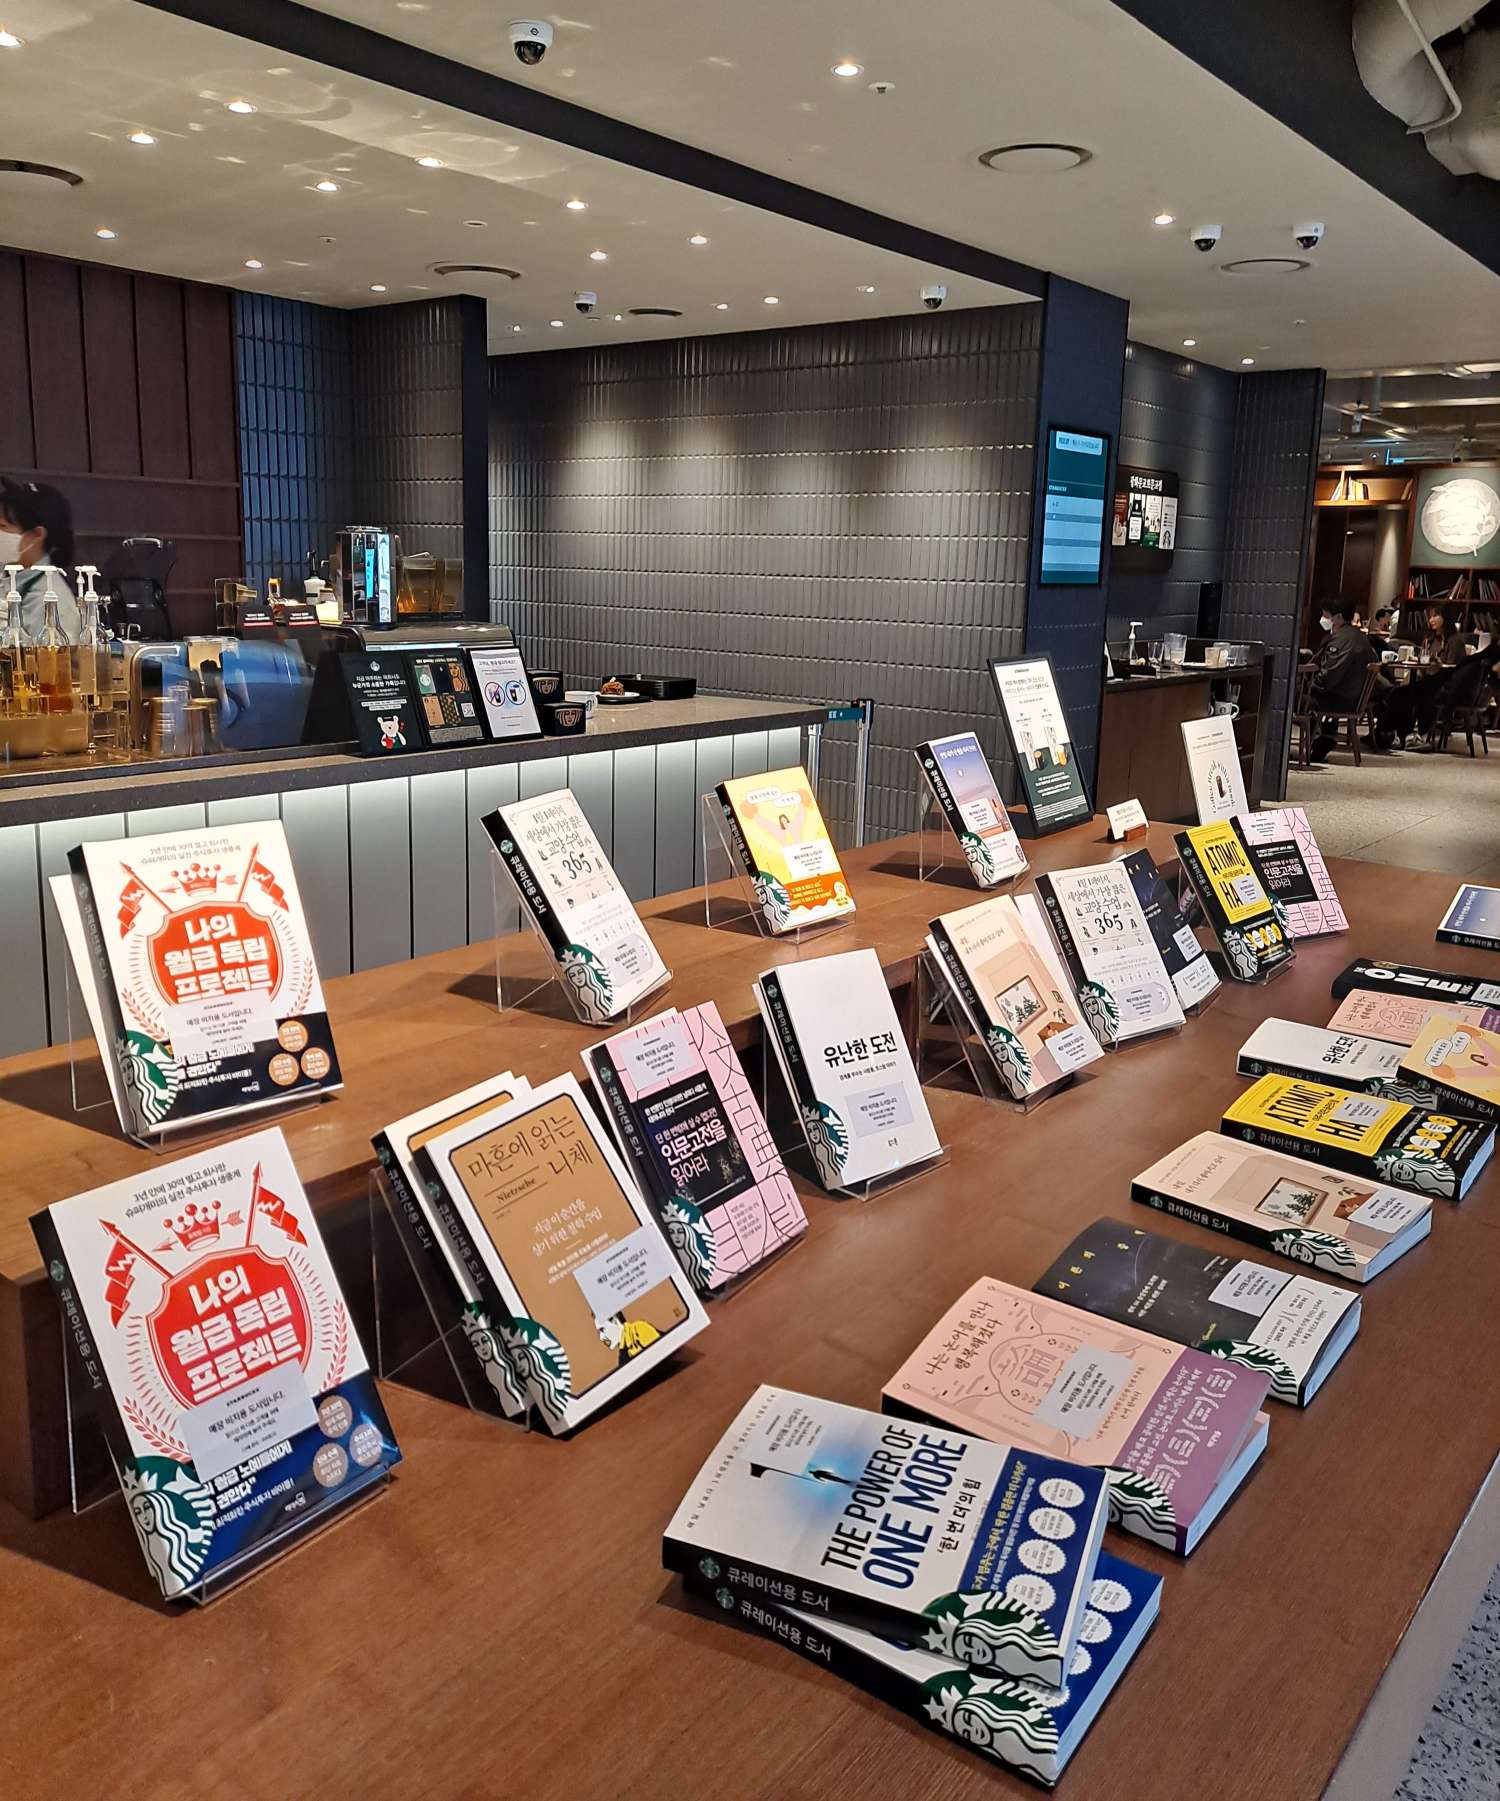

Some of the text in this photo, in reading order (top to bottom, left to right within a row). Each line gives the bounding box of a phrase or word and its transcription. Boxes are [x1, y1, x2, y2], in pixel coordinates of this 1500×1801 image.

[562, 851, 592, 880] 365
[1204, 841, 1246, 875] ATOMIC
[1264, 864, 1303, 879] 인문고전을
[510, 855, 546, 914] 큐레이션용 도서
[1269, 877, 1291, 890] 읽어라
[1083, 897, 1122, 914] 교양 수업
[1095, 912, 1124, 935] 365
[185, 914, 237, 943] 나의
[1065, 942, 1074, 956] 도서
[165, 937, 268, 976] 월급 독립
[176, 968, 273, 1004] 프로젝트
[945, 953, 976, 1006] 큐레이션용 도서
[1363, 967, 1462, 992] ONE
[774, 1002, 799, 1063] 큐레이션용 도서
[824, 1031, 898, 1069] 유난한 도전
[1323, 1036, 1358, 1064] 유난한 도전
[609, 1086, 644, 1156] 큐레이션용 도서
[1263, 1085, 1336, 1128] ATOMIC
[1435, 1086, 1495, 1116] 큐레이션용 도서
[467, 1114, 576, 1179] 마흔에 읽는
[547, 1138, 593, 1176] 니체
[661, 1119, 727, 1166] 인문고전을
[1260, 1133, 1320, 1157] 큐레이션용 도서
[496, 1177, 537, 1203] Nietzsche
[670, 1154, 711, 1187] 읽어라
[124, 1169, 241, 1218] 슈퍼개미의 실전 주식투자 생중계
[388, 1169, 432, 1250] 큐레이션용 도서
[548, 1227, 569, 1245] 위한
[1167, 1204, 1229, 1232] 큐레이션용 도서
[438, 1203, 485, 1285] 큐레이션용 도서
[188, 1265, 253, 1315] 나의
[61, 1288, 102, 1389] 큐레이션용 도서
[170, 1286, 293, 1365] 월급 독립
[925, 1299, 994, 1376] 나는 논어를 만나
[954, 1319, 1003, 1371] 행복해졌다
[187, 1324, 302, 1402] 프로젝트
[207, 1392, 286, 1434] 매장 비치용 도서입니다.
[821, 1424, 919, 1571] THE POWER OF
[862, 1433, 968, 1590] ONE MORE
[727, 1567, 830, 1612] 큐레이션용 도서
[739, 1599, 832, 1662] 큐레이션용 도서
